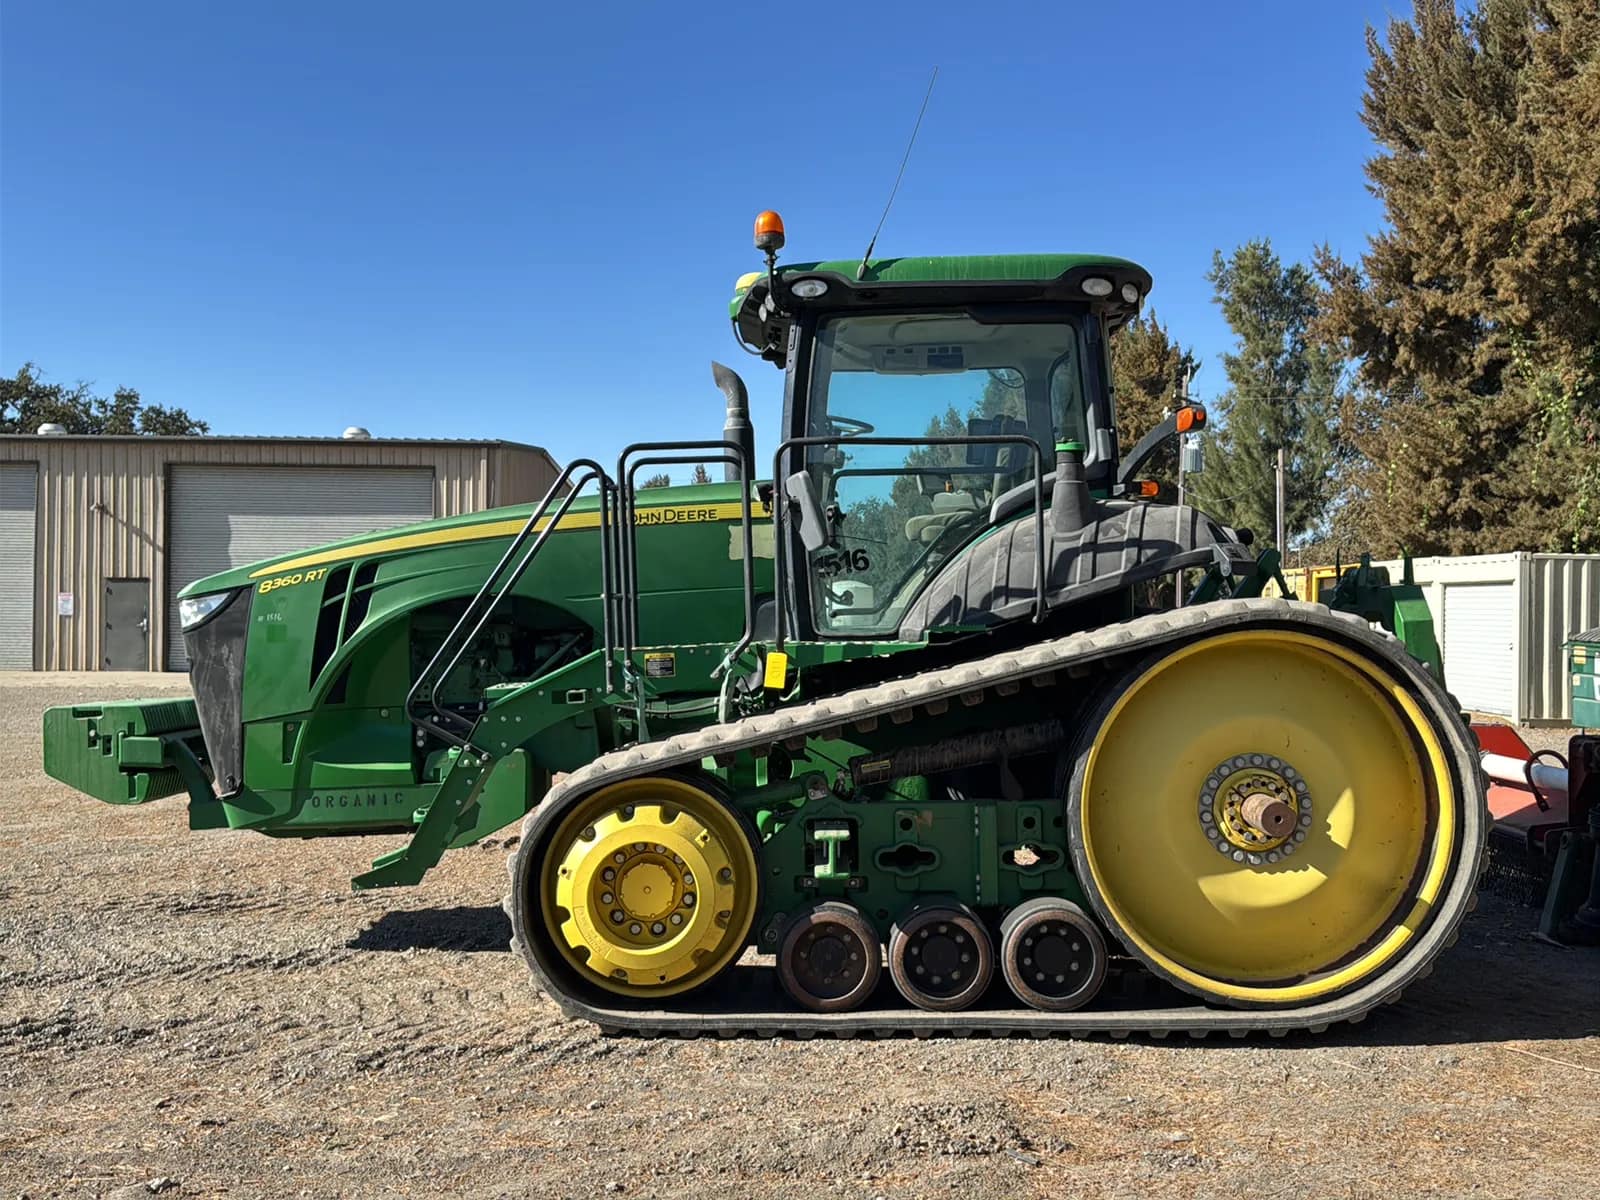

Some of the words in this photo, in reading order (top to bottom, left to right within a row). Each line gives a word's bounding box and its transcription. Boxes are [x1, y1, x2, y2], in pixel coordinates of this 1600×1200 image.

[664, 508, 718, 521] DEERE
[258, 574, 303, 595] 8360
[304, 567, 328, 583] RT
[311, 792, 404, 809] ORGANIC
